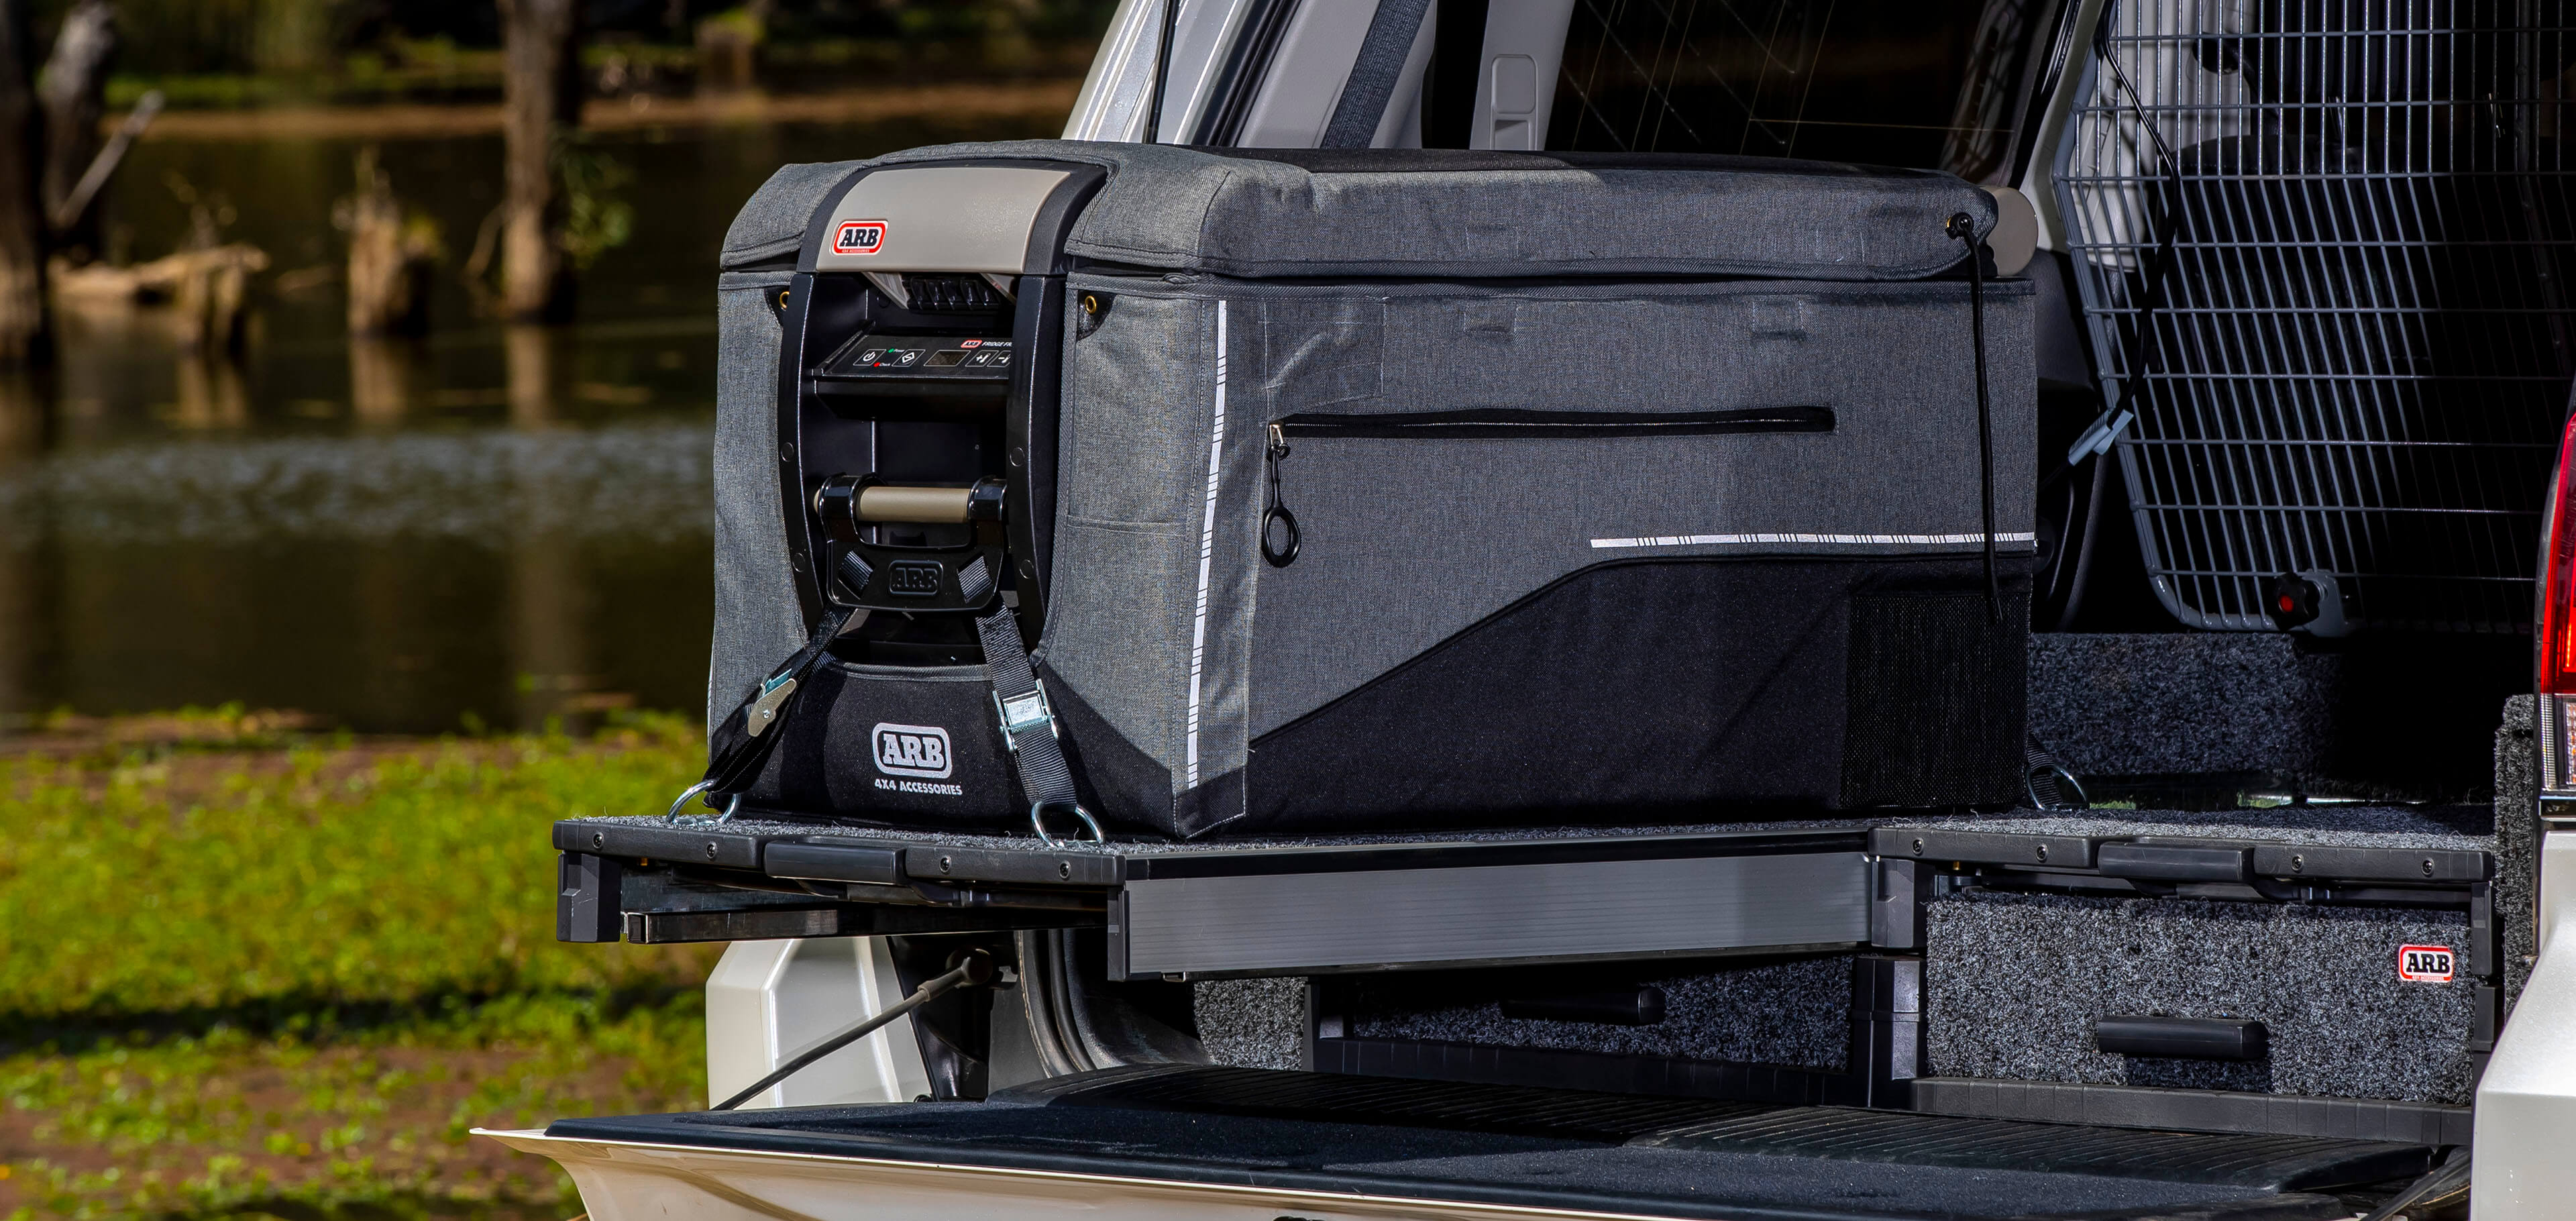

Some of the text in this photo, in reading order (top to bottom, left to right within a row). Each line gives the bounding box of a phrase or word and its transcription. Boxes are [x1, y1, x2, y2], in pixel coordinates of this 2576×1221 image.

[839, 229, 879, 247] ARB
[892, 567, 938, 589] ARB
[883, 733, 945, 769] ARB
[874, 778, 963, 796] 4X4 ACCESSORIES
[2406, 953, 2450, 973] ARB
